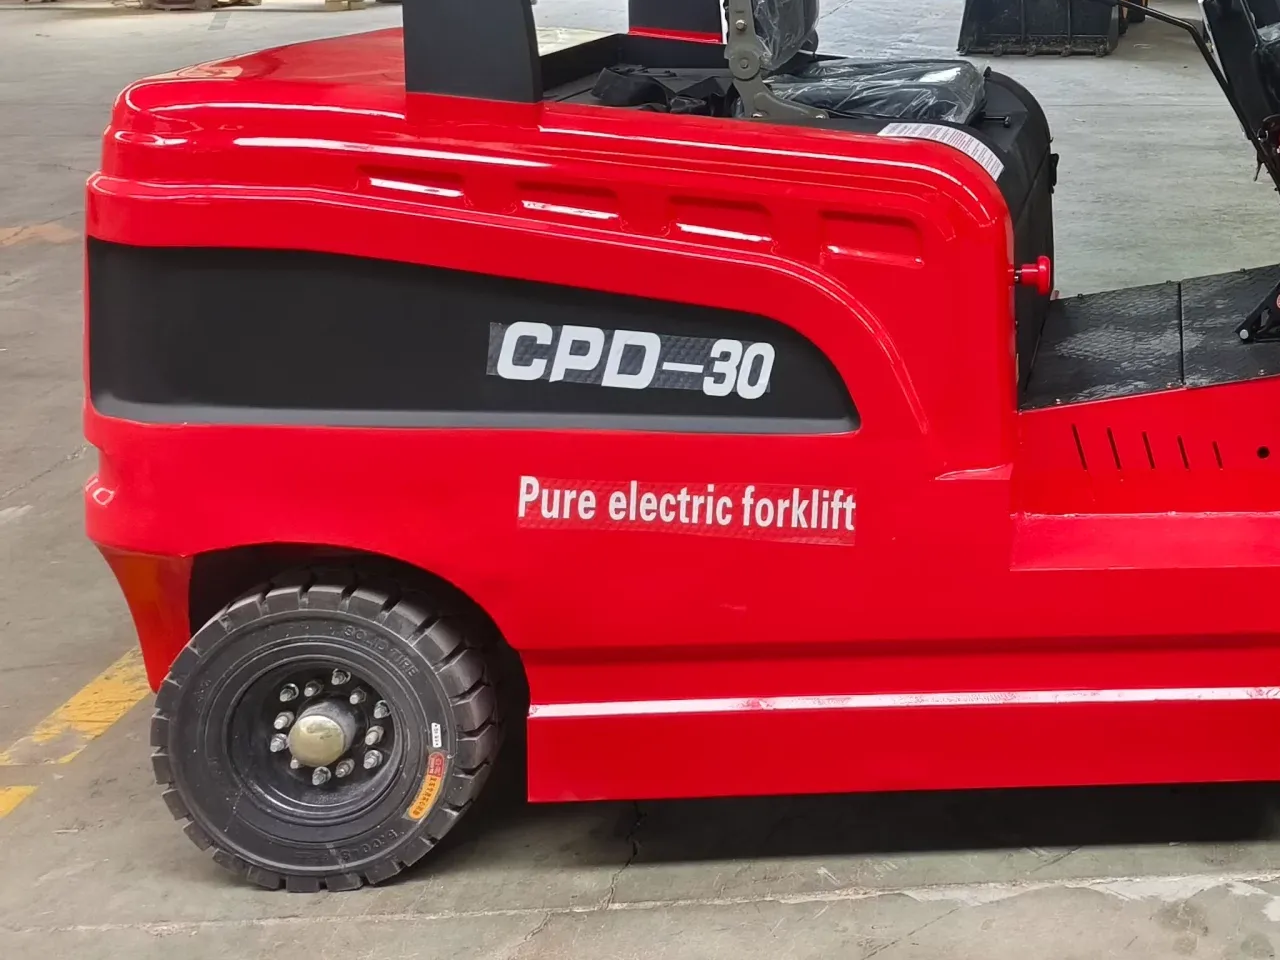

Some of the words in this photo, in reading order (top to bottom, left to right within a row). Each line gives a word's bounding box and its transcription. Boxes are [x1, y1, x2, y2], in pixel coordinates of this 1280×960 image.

[496, 321, 776, 400] CPD-30
[518, 475, 597, 520] Pure
[608, 480, 733, 526] electric
[742, 485, 856, 530] forklift
